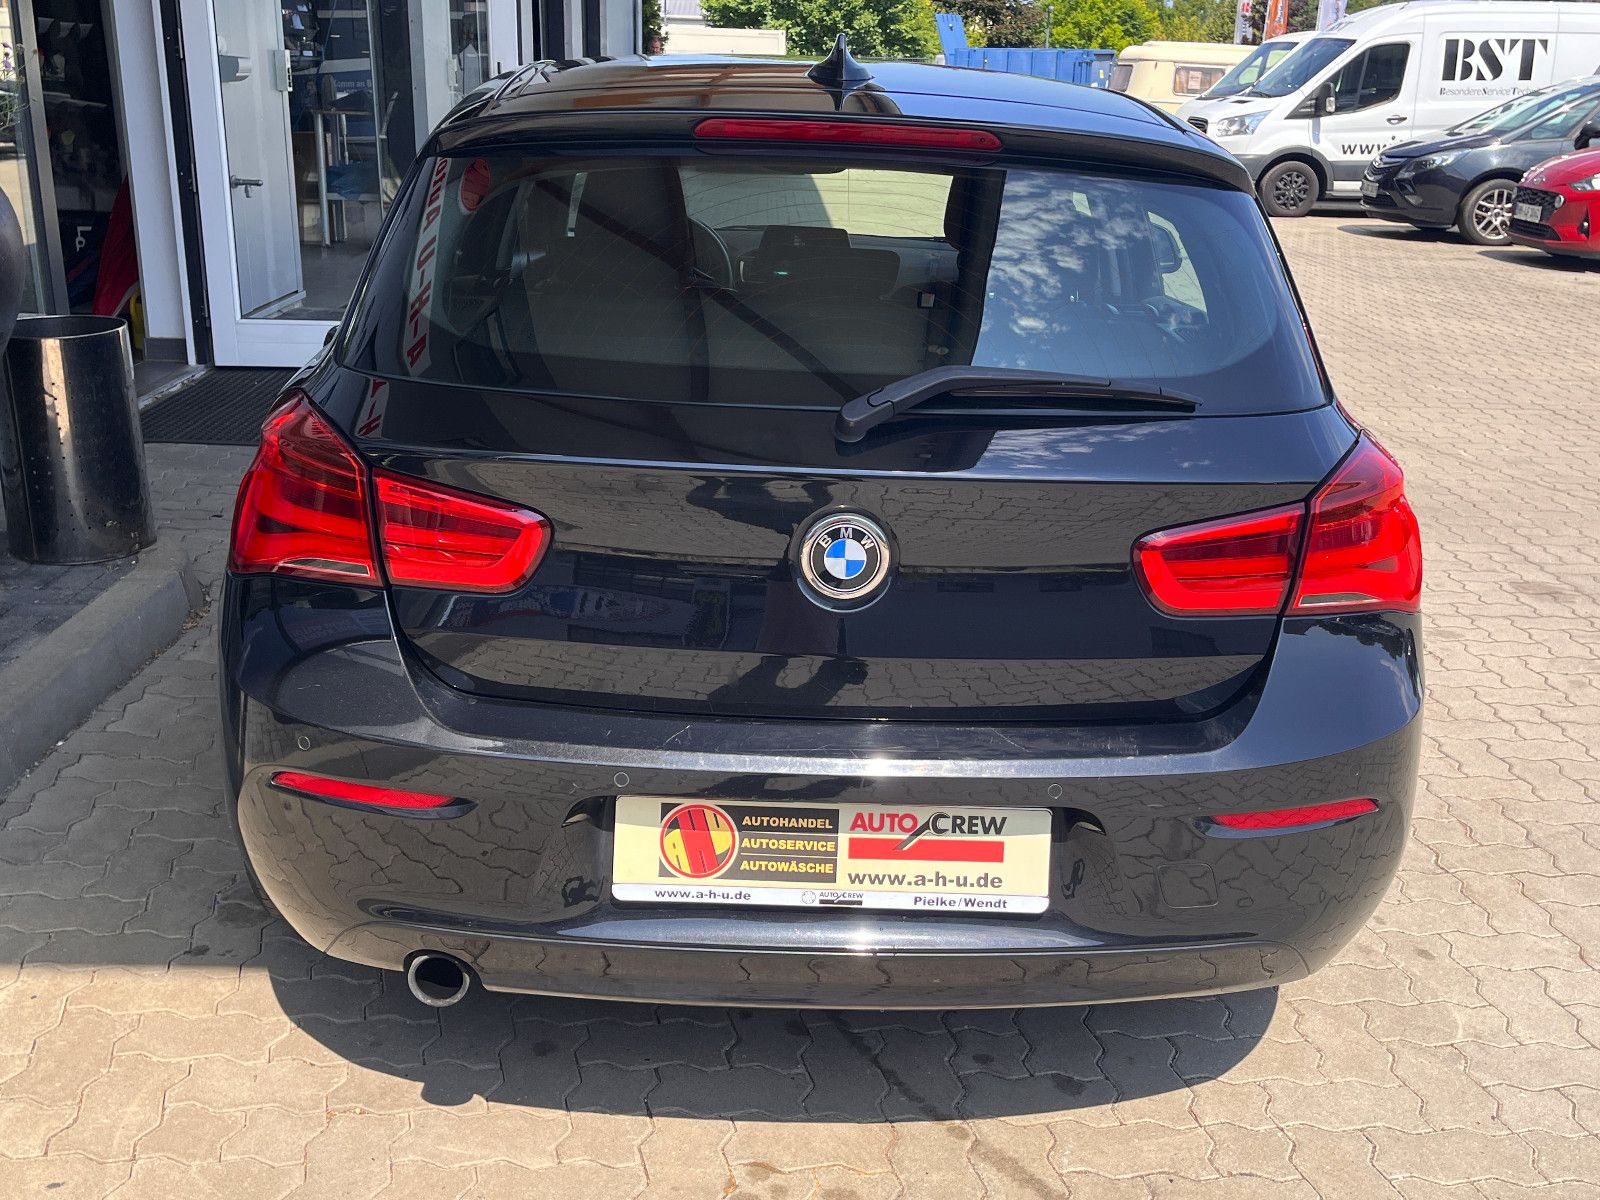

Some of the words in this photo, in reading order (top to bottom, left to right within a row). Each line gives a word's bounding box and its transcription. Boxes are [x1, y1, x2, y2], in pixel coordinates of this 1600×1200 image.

[1441, 38, 1549, 81] BST
[818, 527, 875, 550] BMW
[741, 815, 834, 829] AUTOHANDEL
[848, 811, 919, 833] AUTO
[930, 812, 1008, 836] CREW
[740, 837, 836, 852] AUTOSERVICE
[739, 859, 835, 874] AUTOWÄSCHE
[847, 871, 1004, 889] www.a-h-u.de
[654, 889, 752, 901] www.a-h-u.de
[912, 895, 1009, 910] Pielke/Wendt
